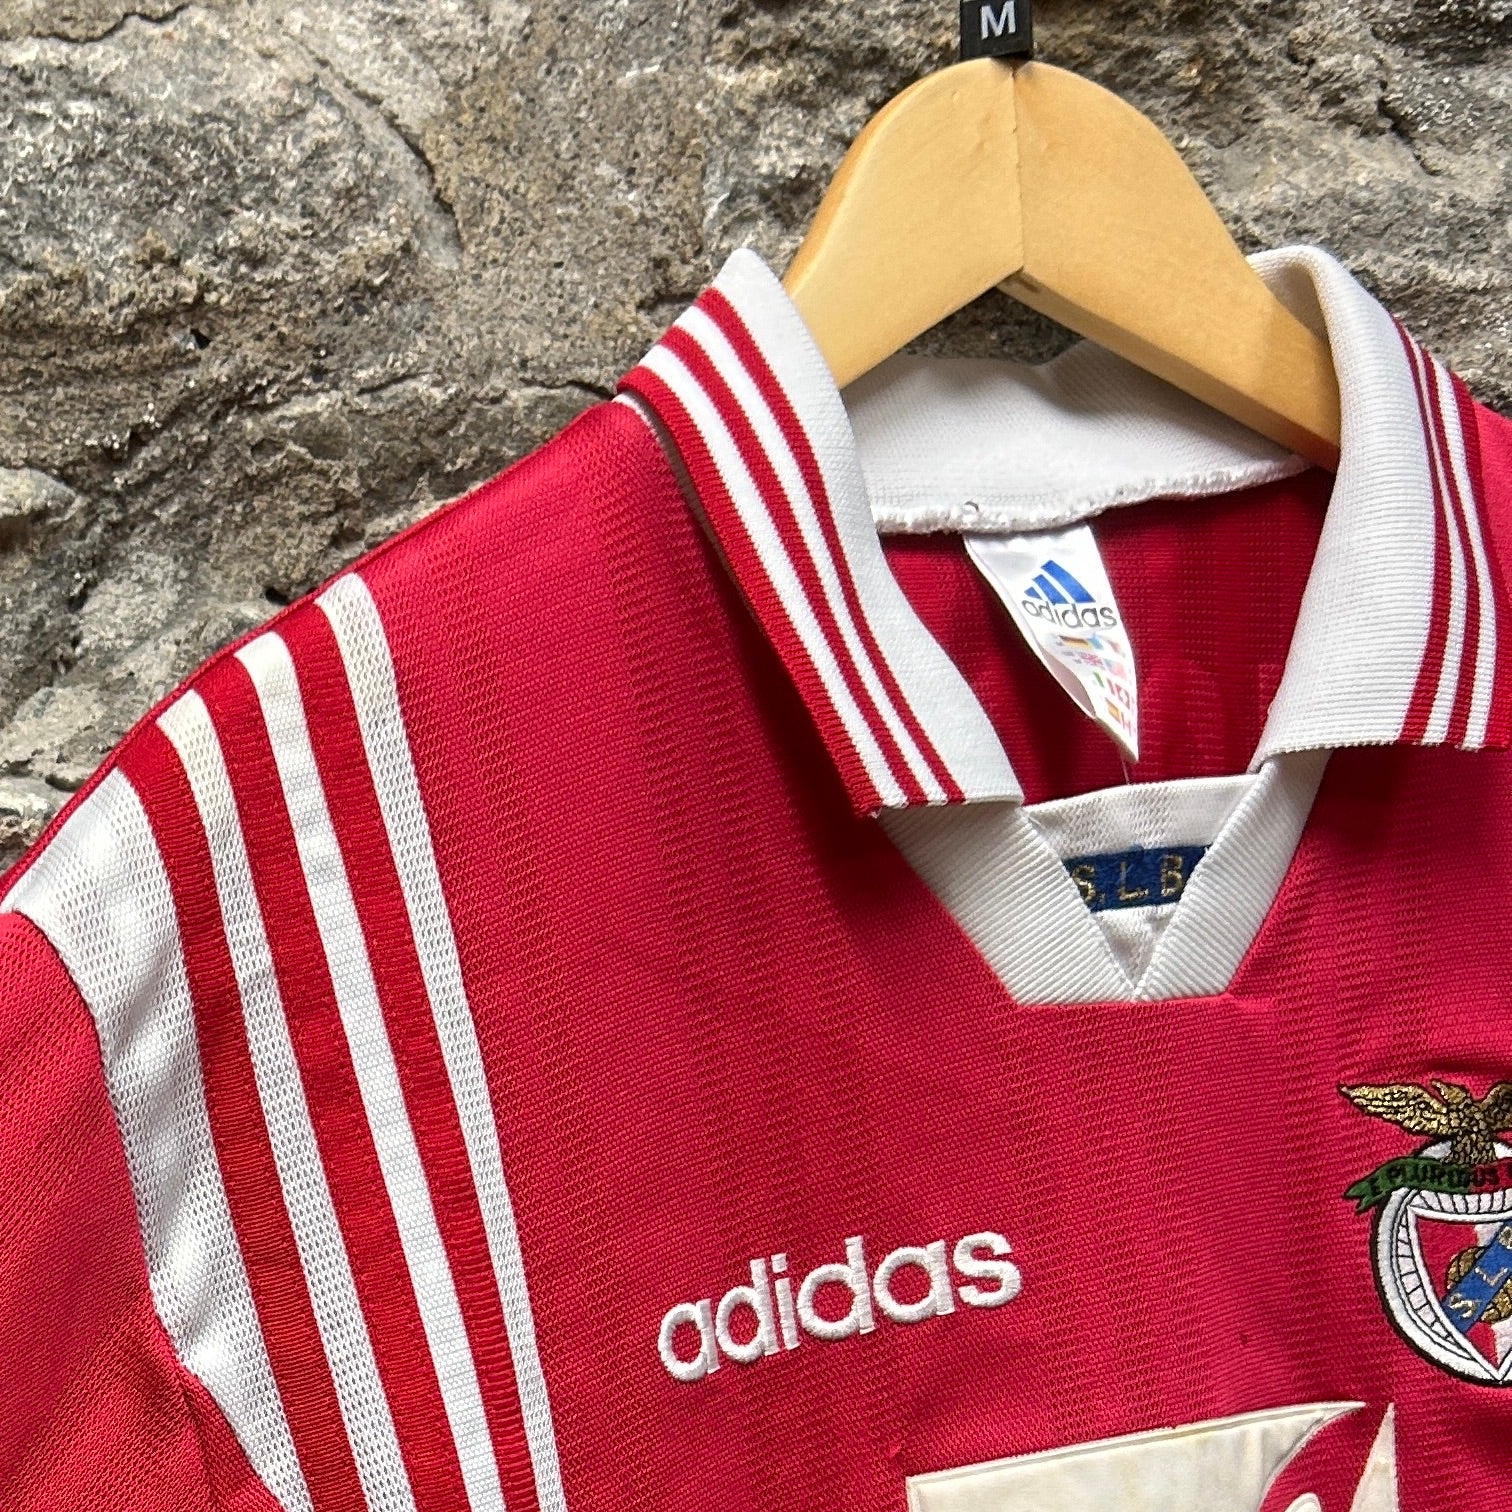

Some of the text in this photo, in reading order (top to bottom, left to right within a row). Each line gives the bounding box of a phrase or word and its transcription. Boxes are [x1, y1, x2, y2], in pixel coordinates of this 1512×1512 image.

[981, 0, 1016, 40] M
[1021, 600, 1118, 629] adidas
[657, 1231, 1022, 1382] adidas
